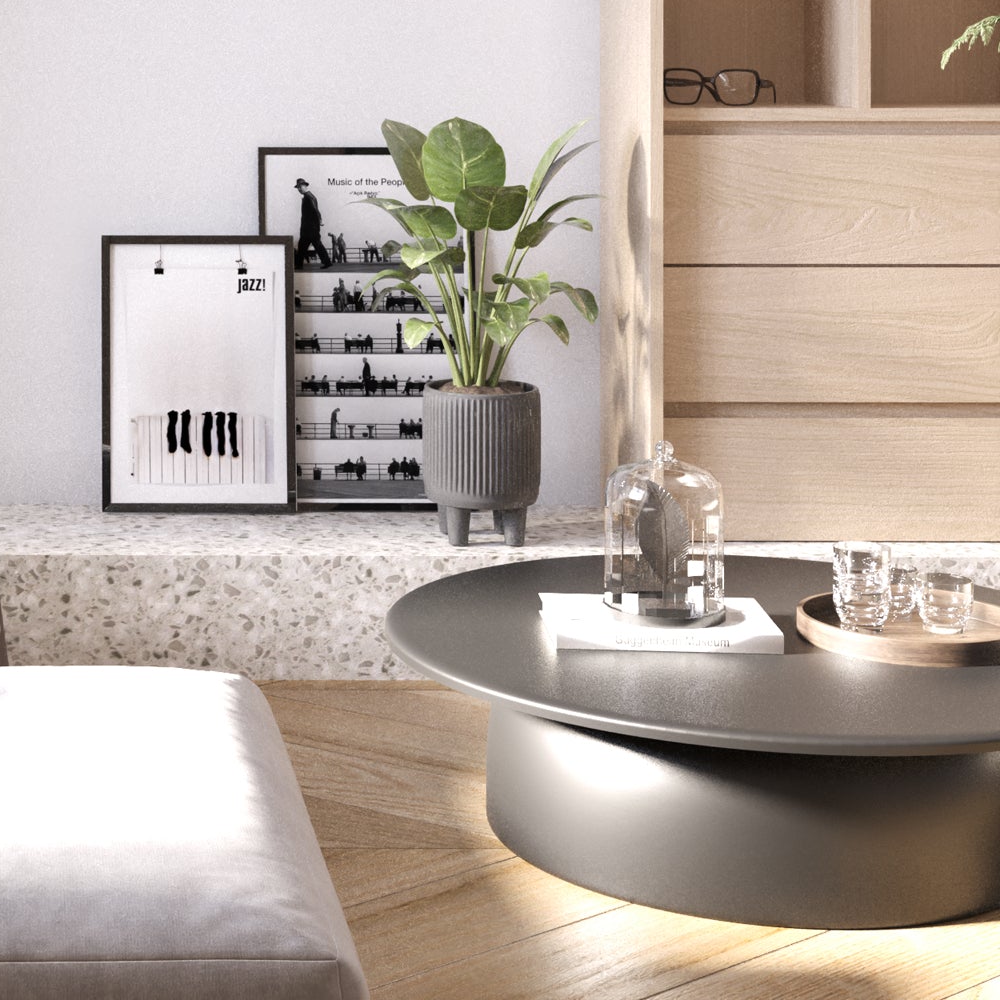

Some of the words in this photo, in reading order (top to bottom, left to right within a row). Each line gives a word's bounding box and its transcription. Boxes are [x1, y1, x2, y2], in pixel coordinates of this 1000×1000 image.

[328, 178, 352, 186] Music
[355, 178, 364, 186] of
[366, 178, 378, 186] the
[380, 178, 404, 188] Peop
[237, 278, 266, 294] jazz!
